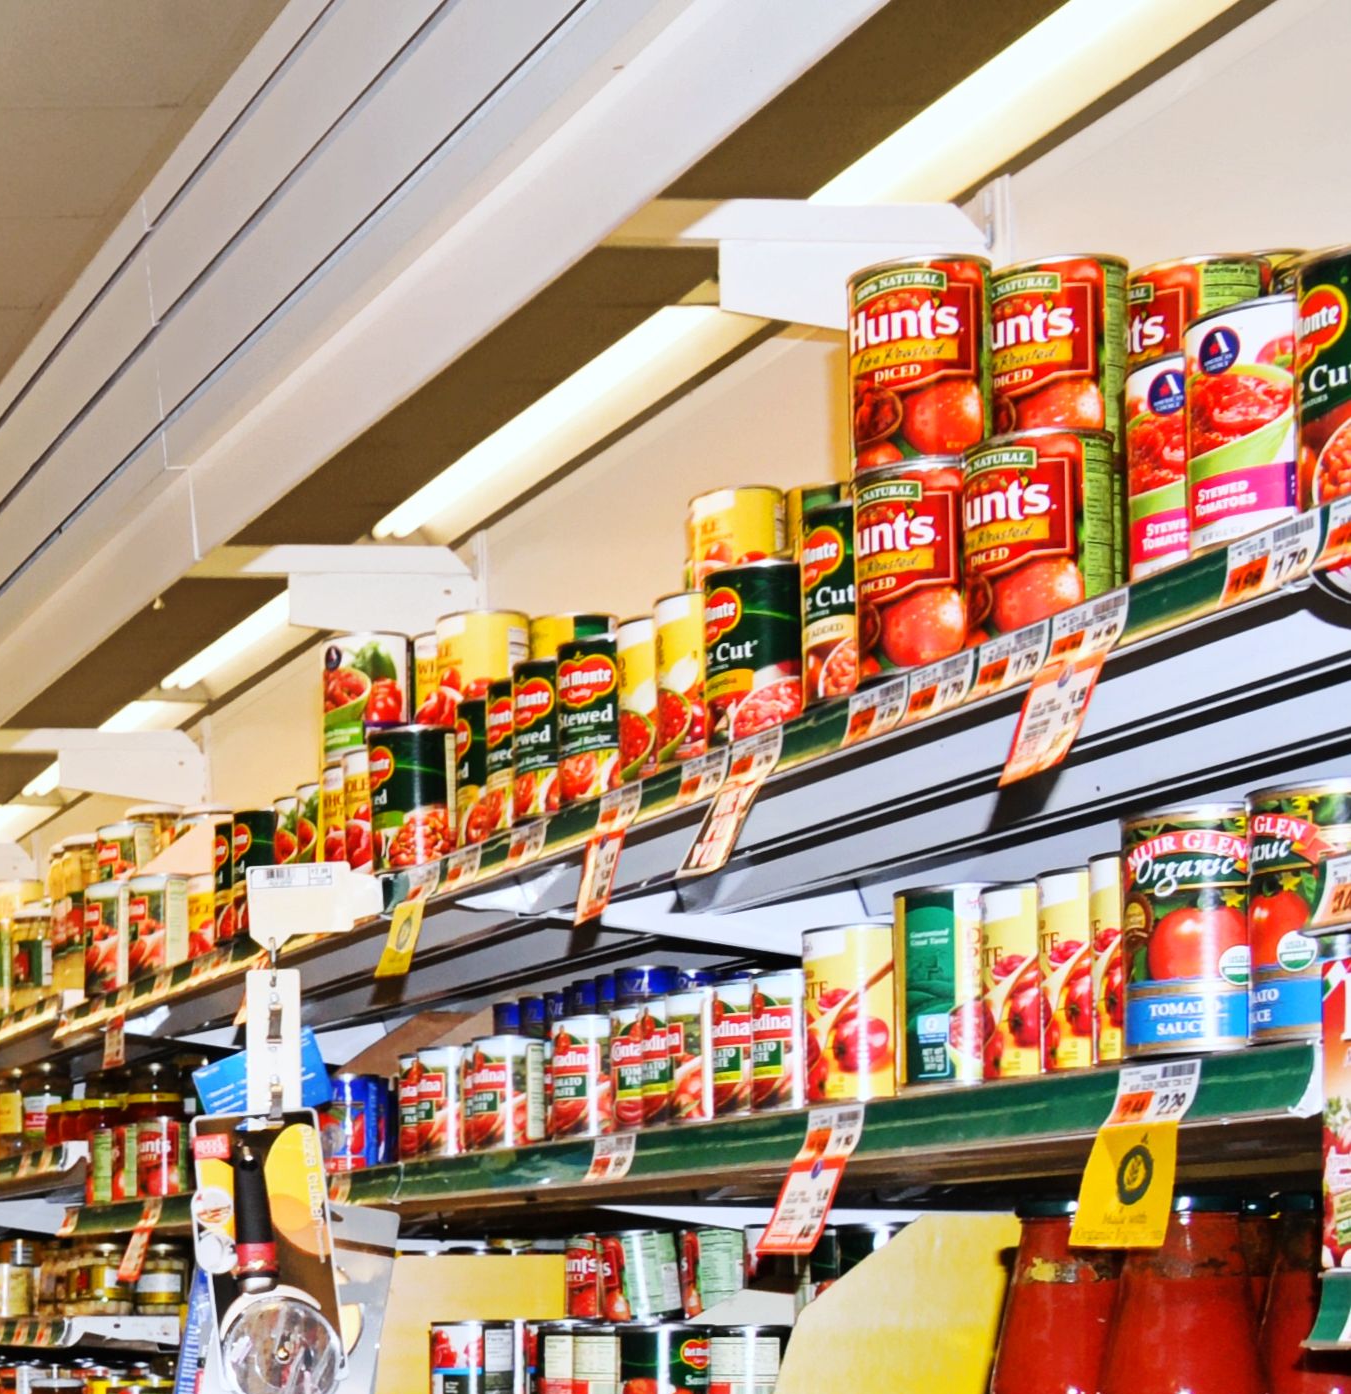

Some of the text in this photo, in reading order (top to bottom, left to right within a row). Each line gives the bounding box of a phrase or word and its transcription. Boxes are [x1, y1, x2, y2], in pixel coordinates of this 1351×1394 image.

[879, 270, 940, 289] NATURAL
[998, 272, 1053, 292] NATURAL
[850, 301, 960, 355] Hunt's
[874, 363, 922, 385] DICED
[974, 453, 1028, 471] NATURAL
[863, 484, 914, 505] NATURAL
[1197, 480, 1249, 503] STEWED
[1195, 492, 1258, 517] TOMATOES
[970, 547, 1010, 568] DICED
[860, 576, 897, 595] DICED
[571, 666, 612, 687] Monte
[1254, 815, 1306, 841] GLEN
[1128, 832, 1248, 872] MUIR GLEN
[1136, 856, 1235, 897] Organic
[307, 1170, 324, 1219] cutter
